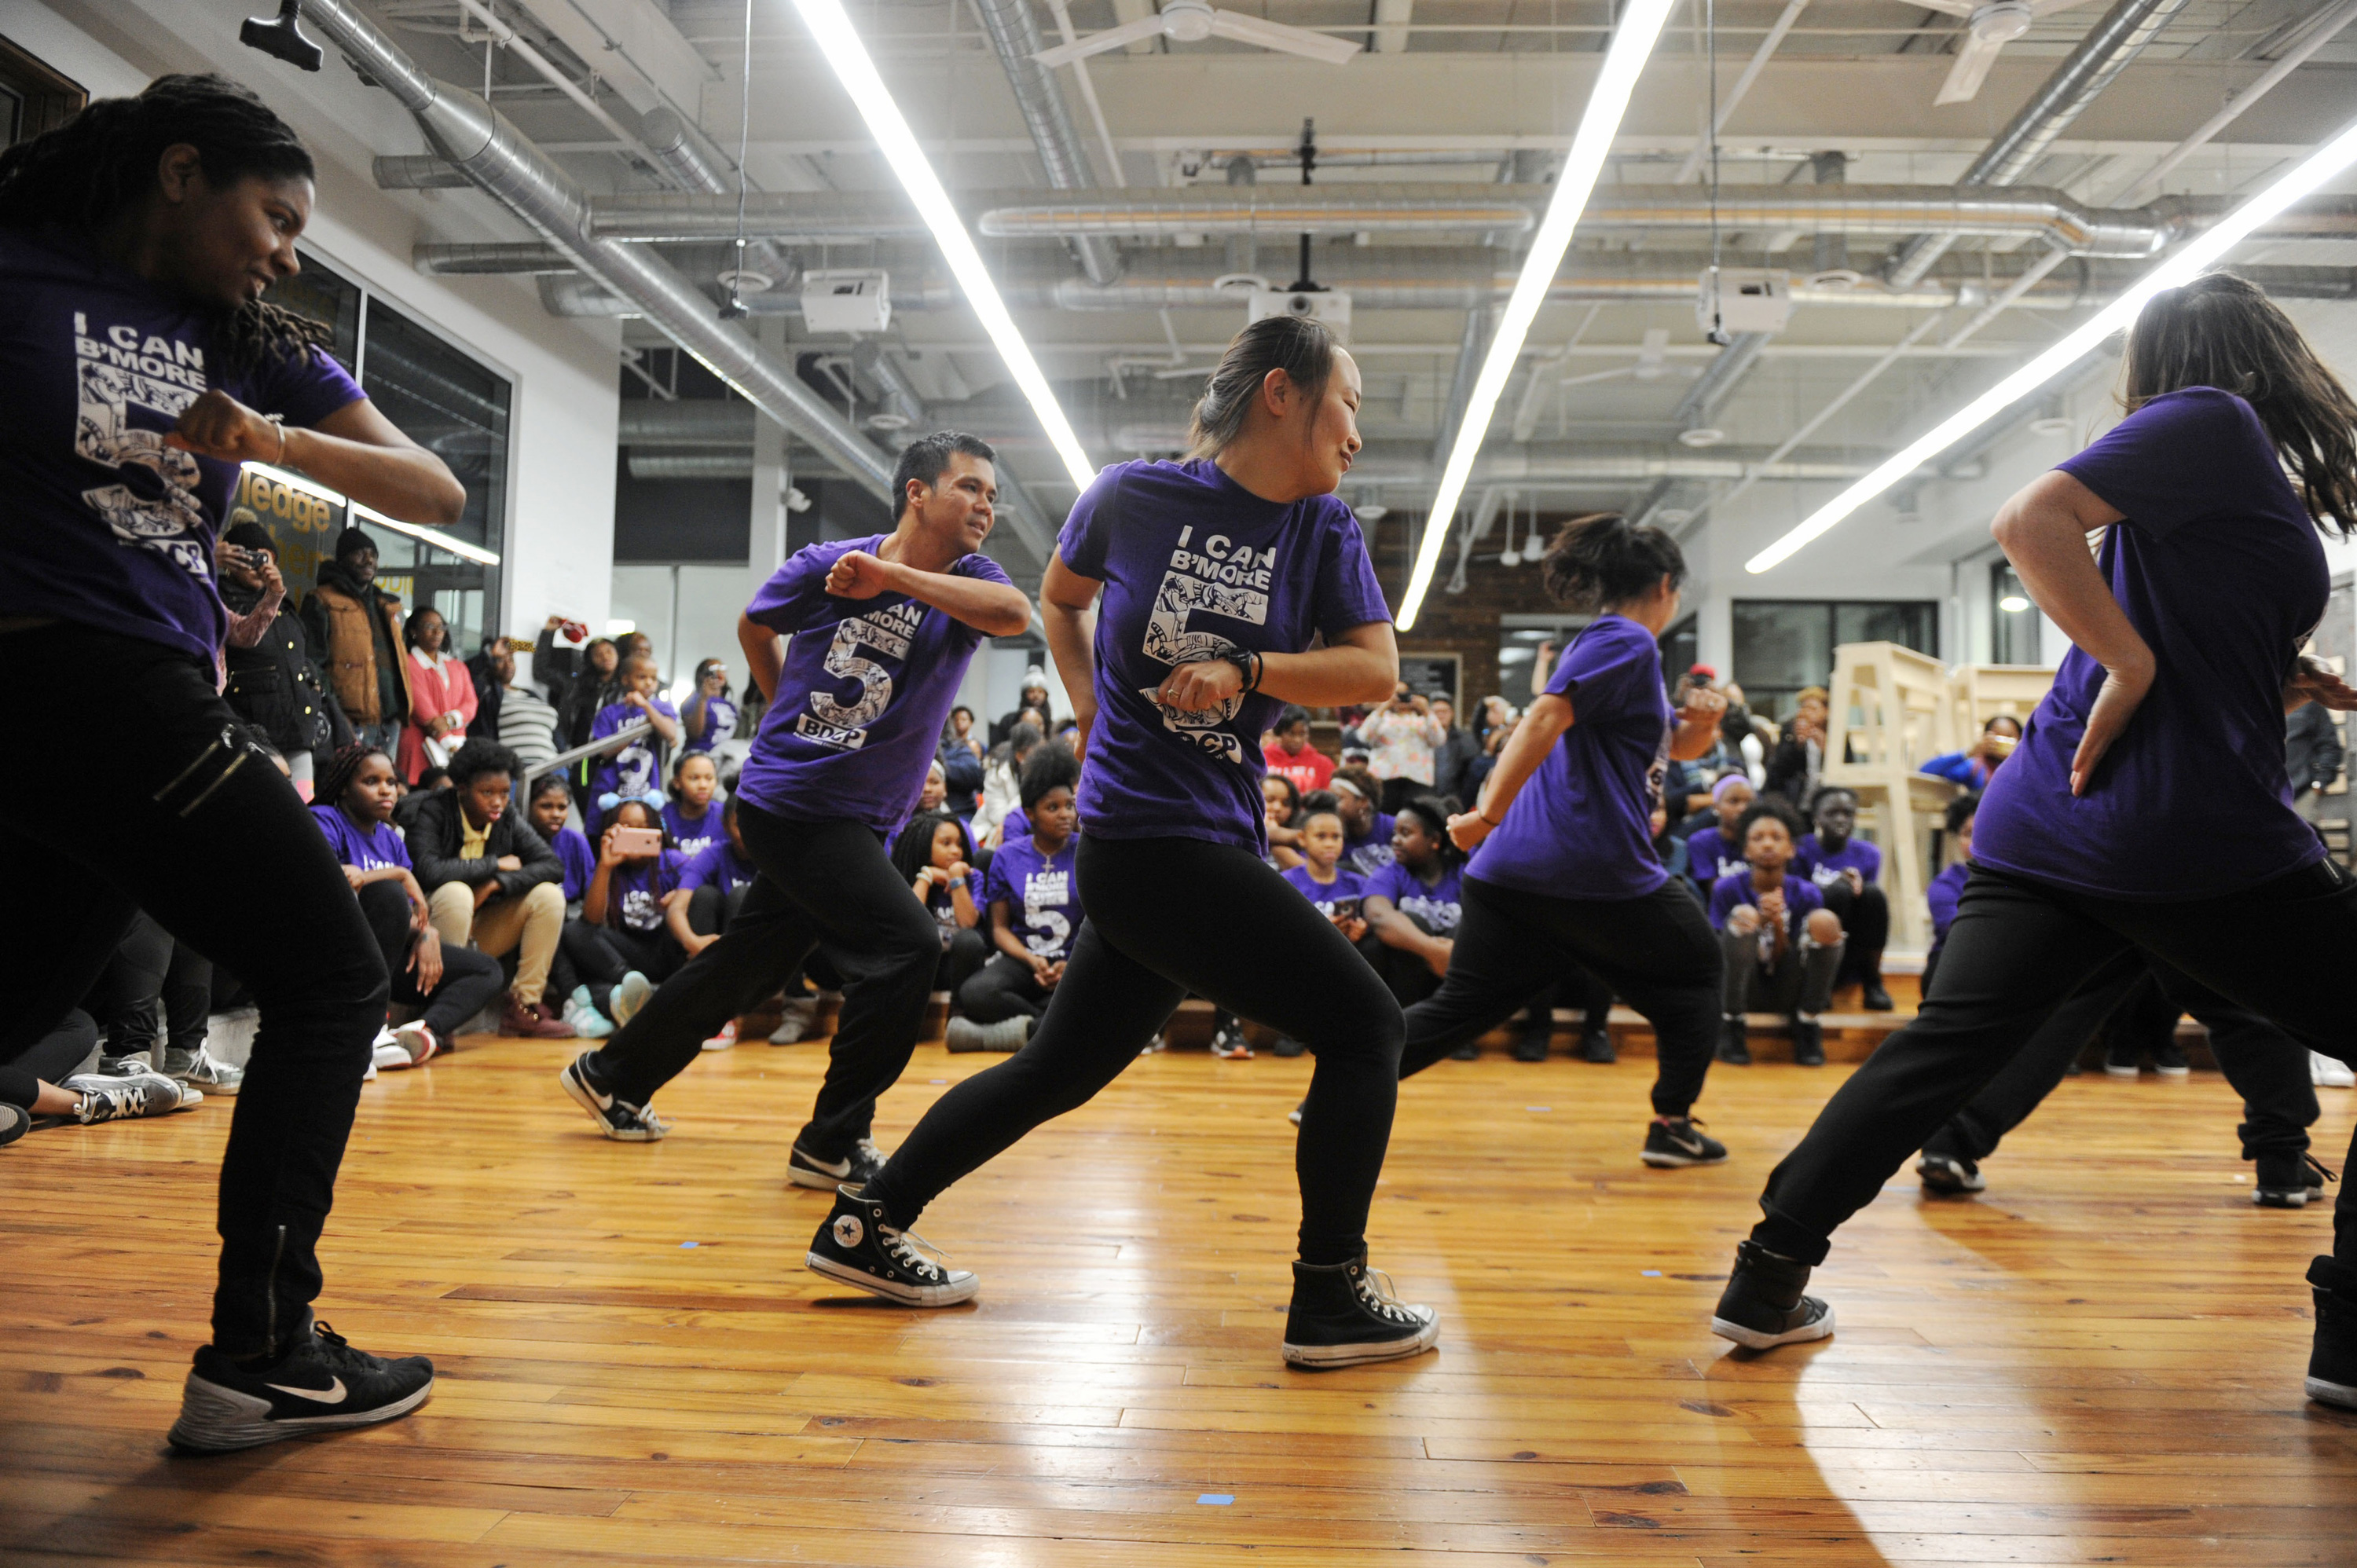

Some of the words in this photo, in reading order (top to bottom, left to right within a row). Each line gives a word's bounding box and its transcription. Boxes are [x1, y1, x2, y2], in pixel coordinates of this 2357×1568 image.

[74, 311, 87, 336] I
[108, 325, 204, 372] CAN
[75, 335, 208, 393] B'MORE
[1170, 549, 1272, 591] B'MORE
[1177, 525, 1193, 548] I
[1205, 534, 1277, 570] CAN
[863, 610, 916, 639] MORE
[885, 603, 922, 626] AN
[810, 617, 914, 729] 5
